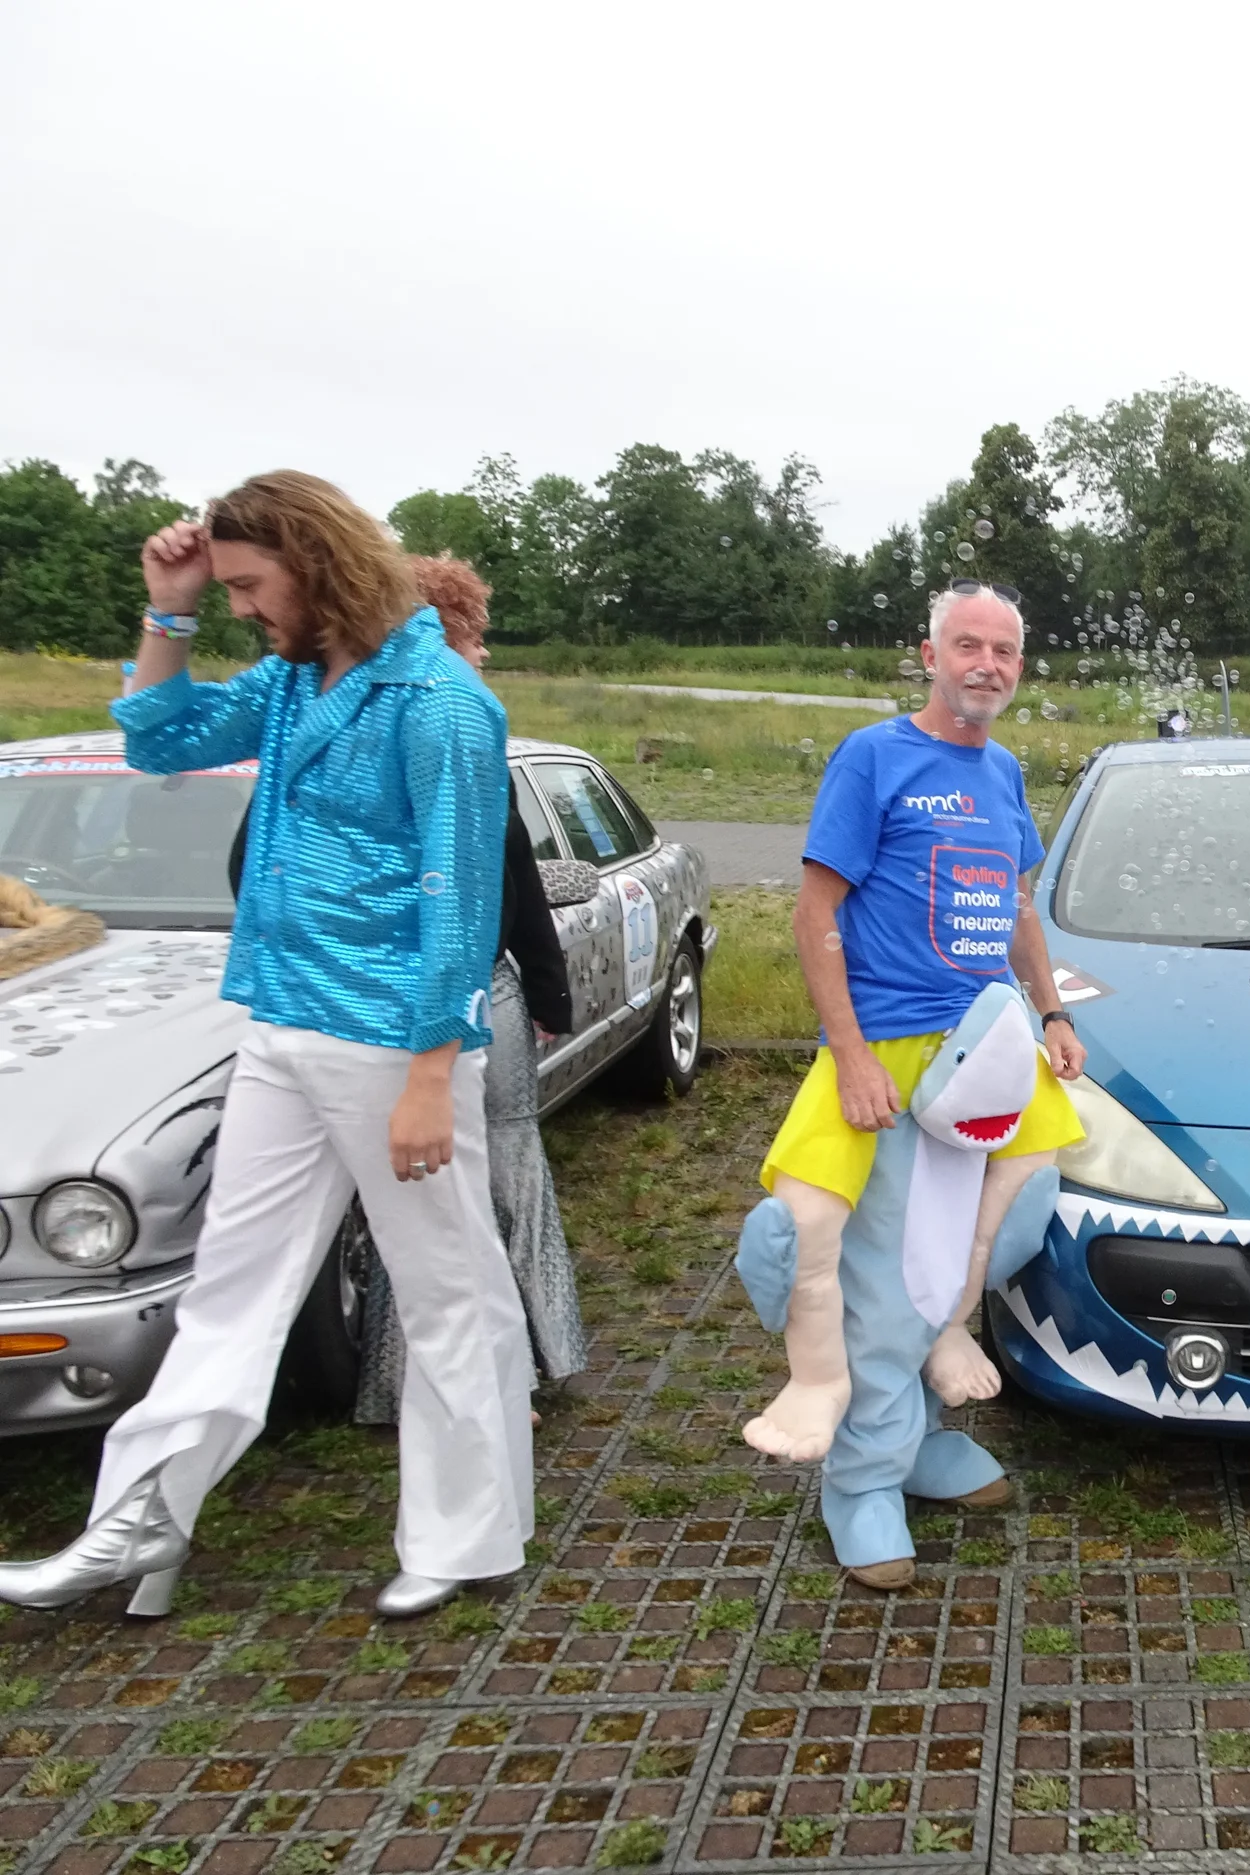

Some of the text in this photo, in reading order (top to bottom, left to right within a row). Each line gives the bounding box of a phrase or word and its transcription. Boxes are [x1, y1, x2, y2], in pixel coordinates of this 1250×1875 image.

[906, 789, 975, 814] mnda
[952, 864, 1008, 889] fighting
[953, 890, 1001, 907] motor
[950, 937, 1008, 956] diseas
